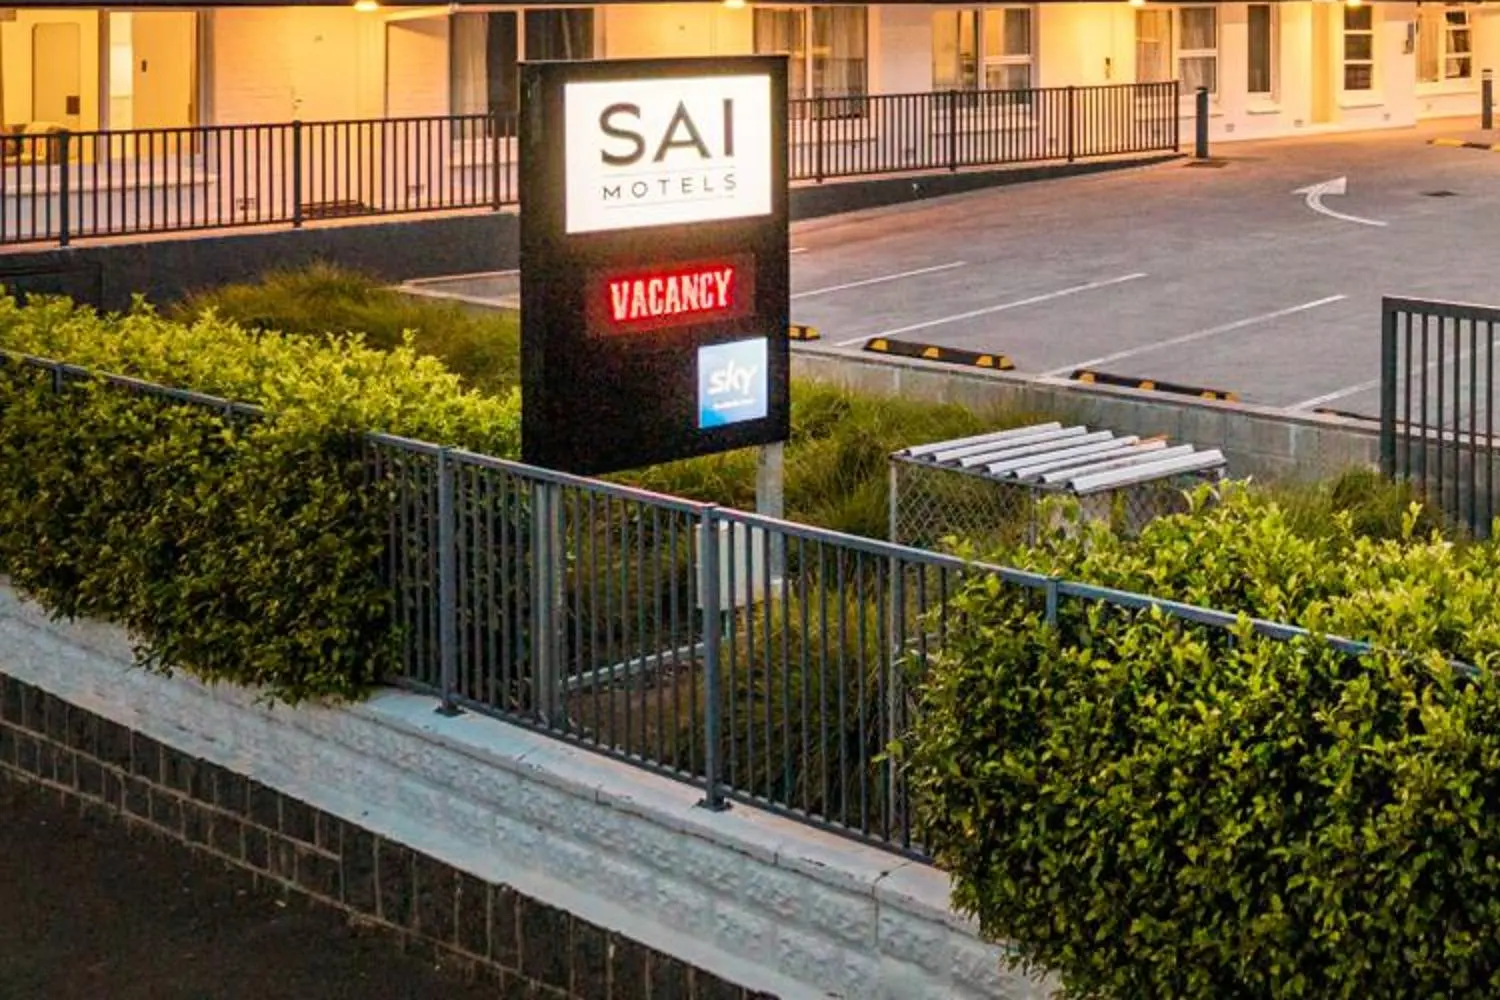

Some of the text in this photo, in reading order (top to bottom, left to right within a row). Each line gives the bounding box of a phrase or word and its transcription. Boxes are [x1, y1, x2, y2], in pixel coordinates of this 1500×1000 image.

[599, 99, 735, 167] SAI
[603, 173, 737, 199] MOTELS
[610, 268, 734, 321] VACANCY
[707, 359, 758, 396] sky
